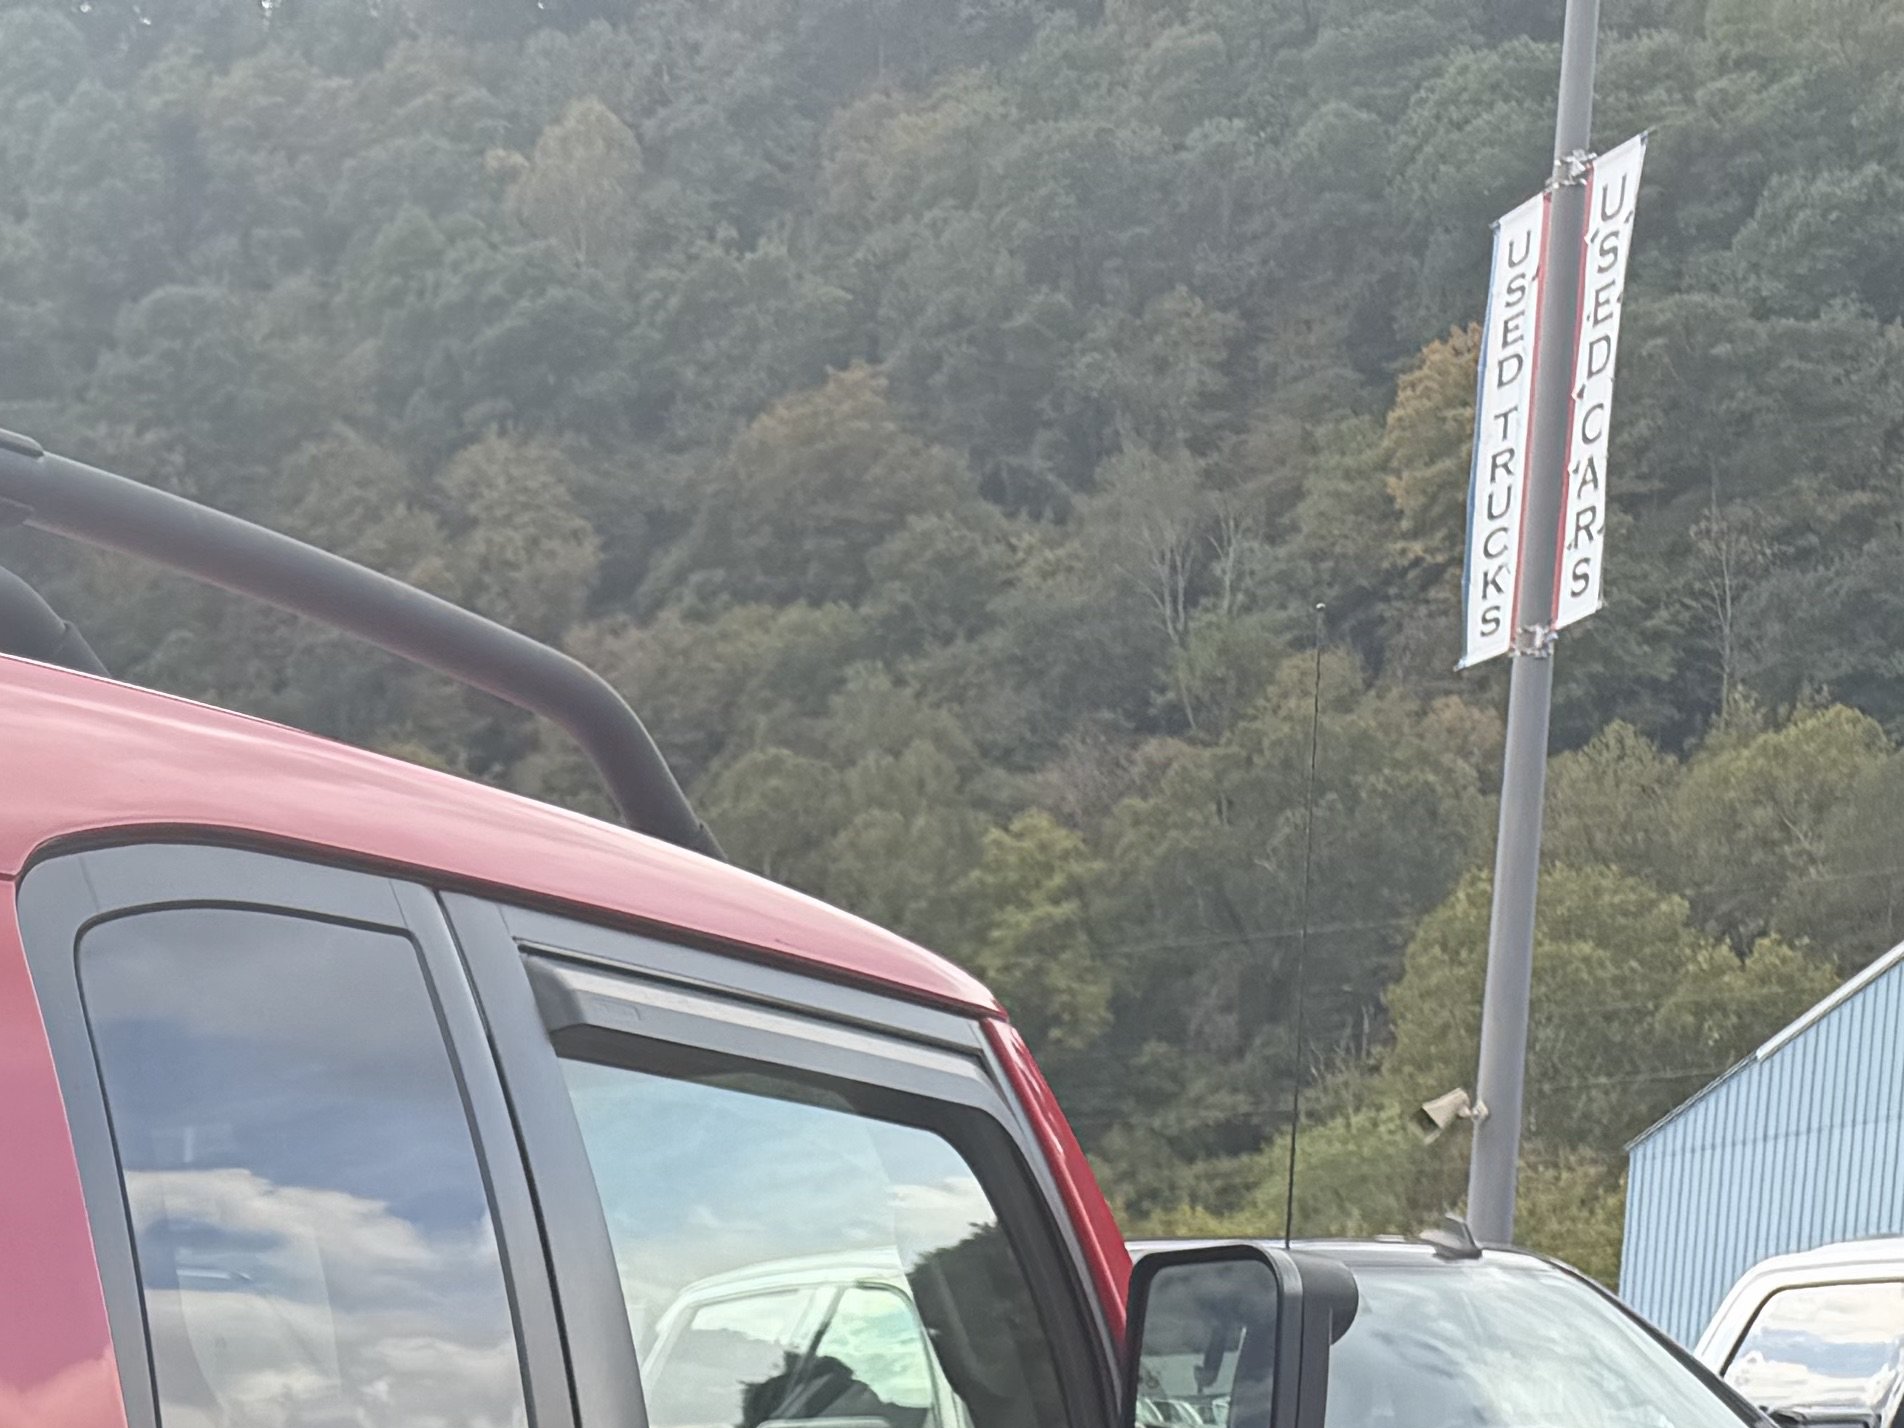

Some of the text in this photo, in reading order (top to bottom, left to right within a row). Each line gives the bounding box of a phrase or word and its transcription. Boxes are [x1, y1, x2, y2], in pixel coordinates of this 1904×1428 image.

[1479, 230, 1533, 638] USED TRUCKS
[1570, 172, 1629, 599] USED CARS
